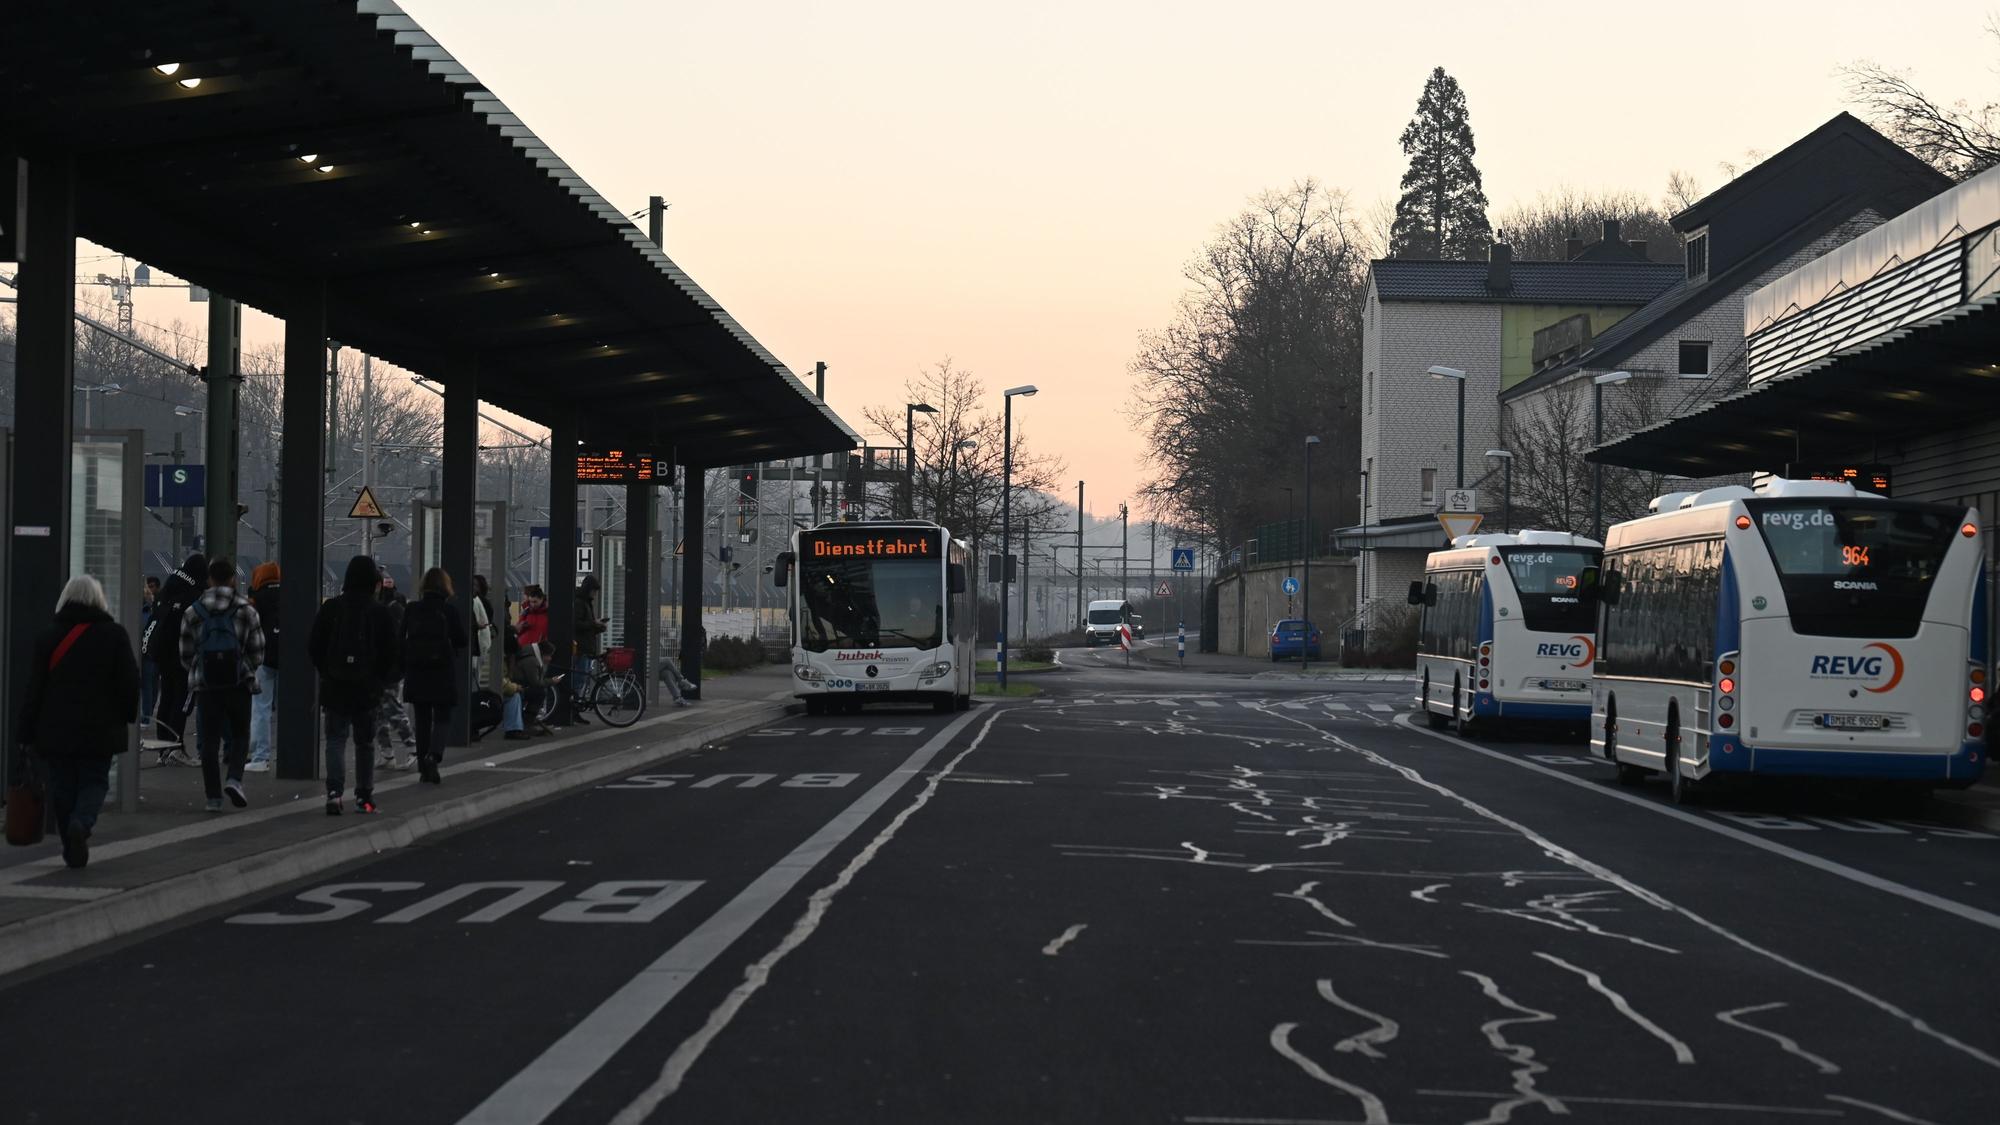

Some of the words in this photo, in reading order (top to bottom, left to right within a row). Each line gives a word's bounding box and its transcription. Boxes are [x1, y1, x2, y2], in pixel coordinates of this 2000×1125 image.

[174, 469, 187, 484] S
[656, 461, 669, 477] B
[1762, 509, 1835, 530] revg.de
[813, 537, 928, 556] Dienstfahrt
[579, 549, 592, 570] H
[1507, 553, 1553, 566] revg.de
[1842, 545, 1870, 566] 964
[1833, 581, 1879, 591] SCANIA
[835, 650, 884, 661] bubak
[1537, 643, 1582, 657] REVG
[1811, 655, 1883, 676] REVG
[598, 772, 862, 788] BUS
[224, 879, 707, 925] BUS
